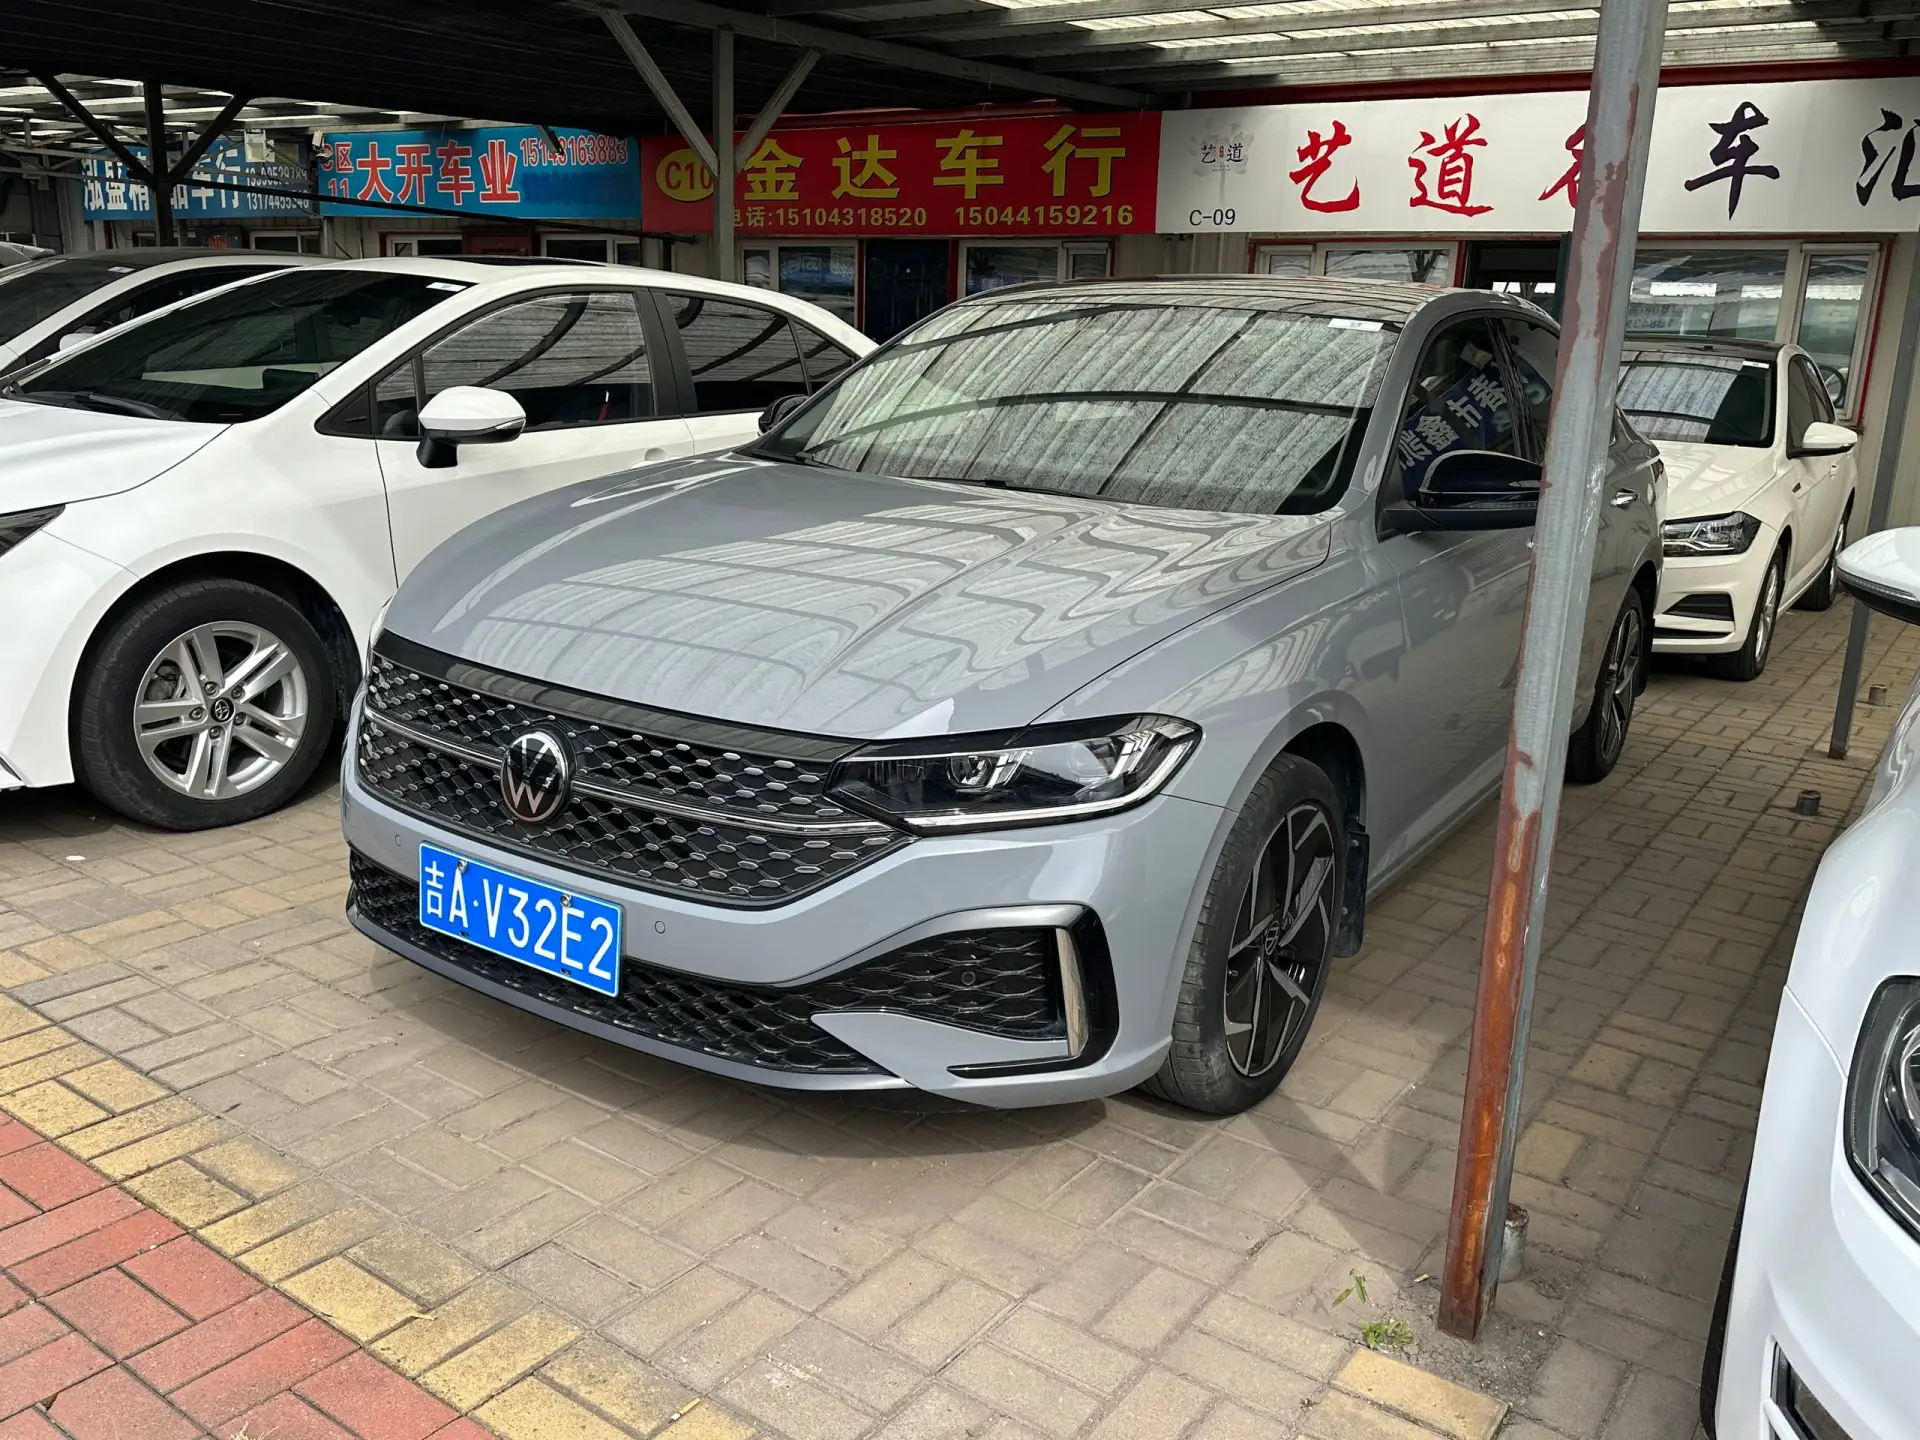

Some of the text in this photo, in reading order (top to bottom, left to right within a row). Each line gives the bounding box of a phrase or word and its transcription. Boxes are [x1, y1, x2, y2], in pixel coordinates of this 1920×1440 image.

[742, 123, 1126, 201] 金达车行
[1200, 142, 1244, 164] 艺道
[356, 139, 520, 205] 大开车业
[328, 177, 350, 201] 11
[955, 204, 1134, 226] 15044159216
[1189, 208, 1236, 226] C-09
